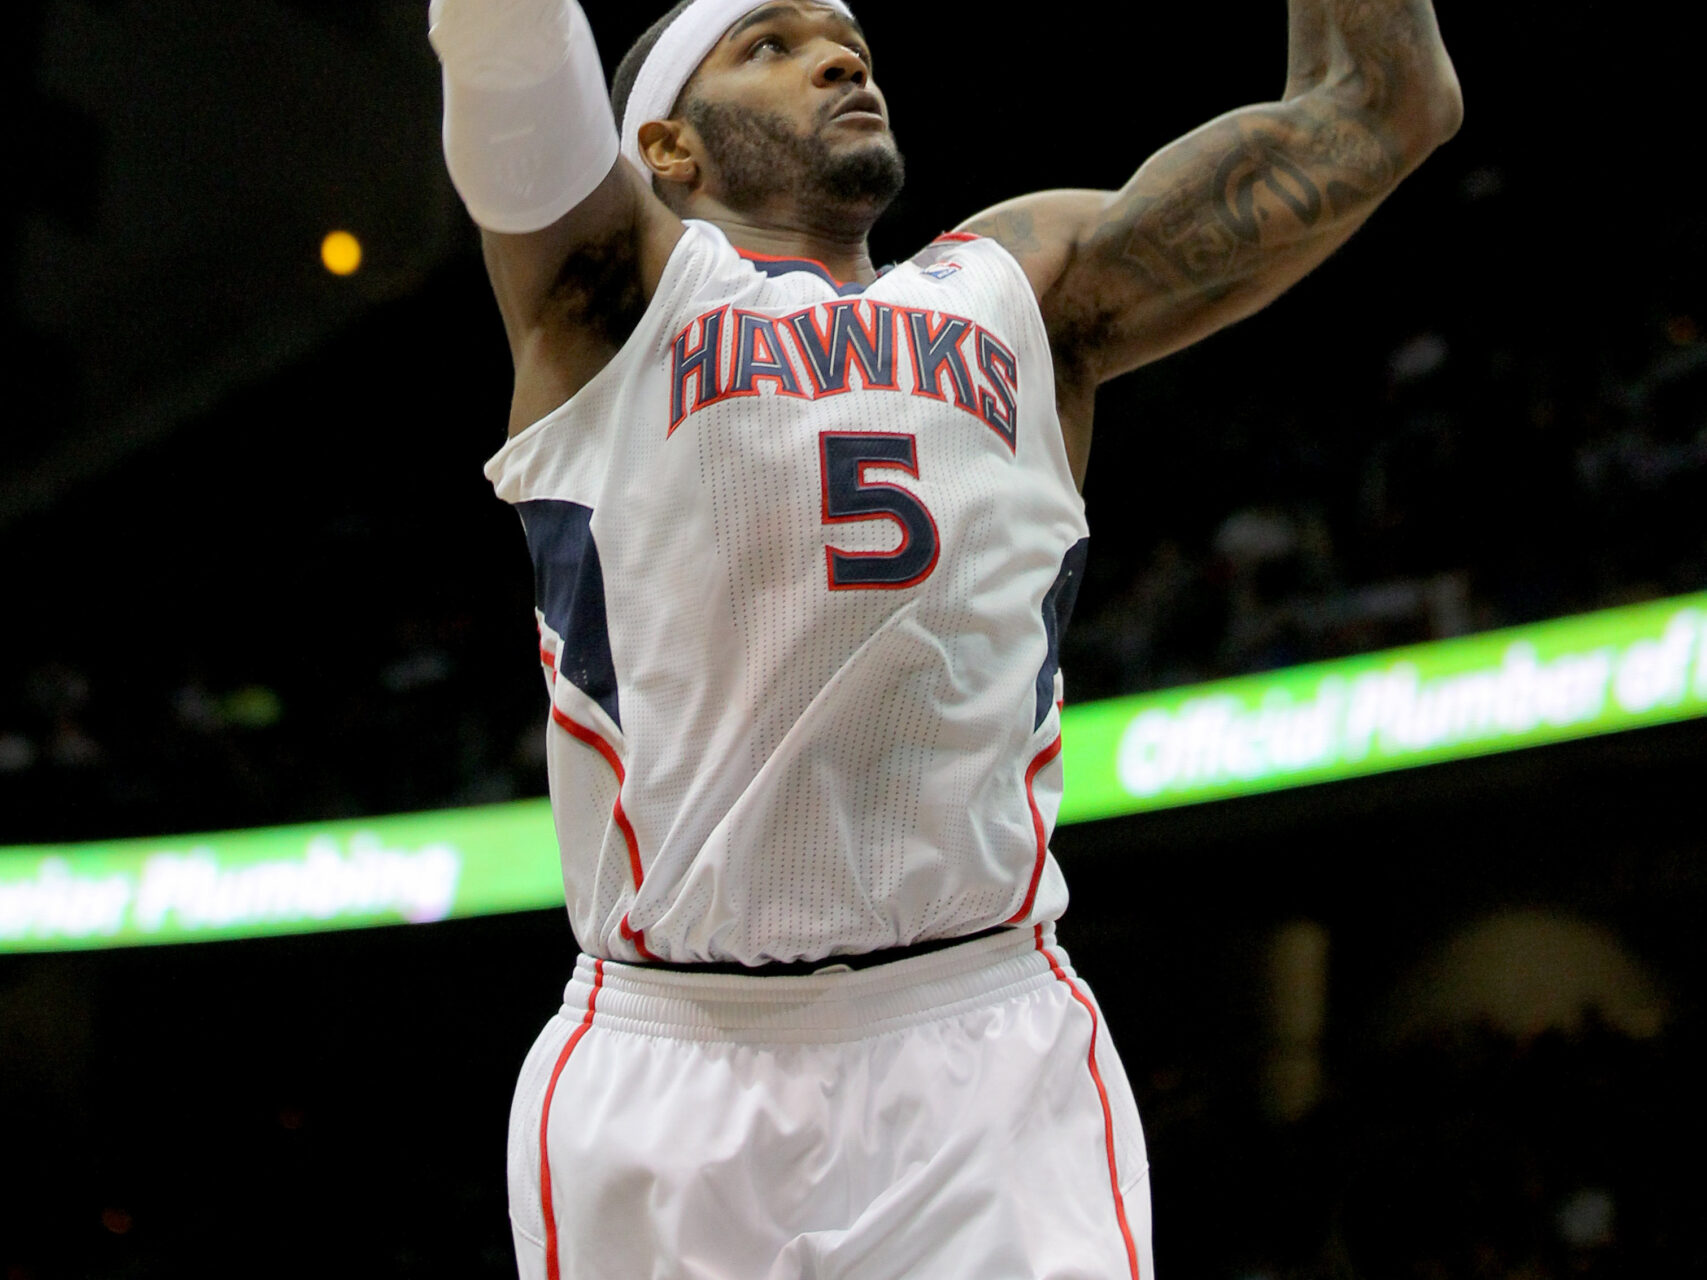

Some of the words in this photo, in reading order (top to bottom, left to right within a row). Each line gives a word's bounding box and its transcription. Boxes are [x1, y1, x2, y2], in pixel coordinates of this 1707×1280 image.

[666, 299, 1017, 455] HAWKS
[819, 431, 940, 591] 5
[1341, 641, 1614, 762] Plumber
[136, 832, 461, 930] Plumbing
